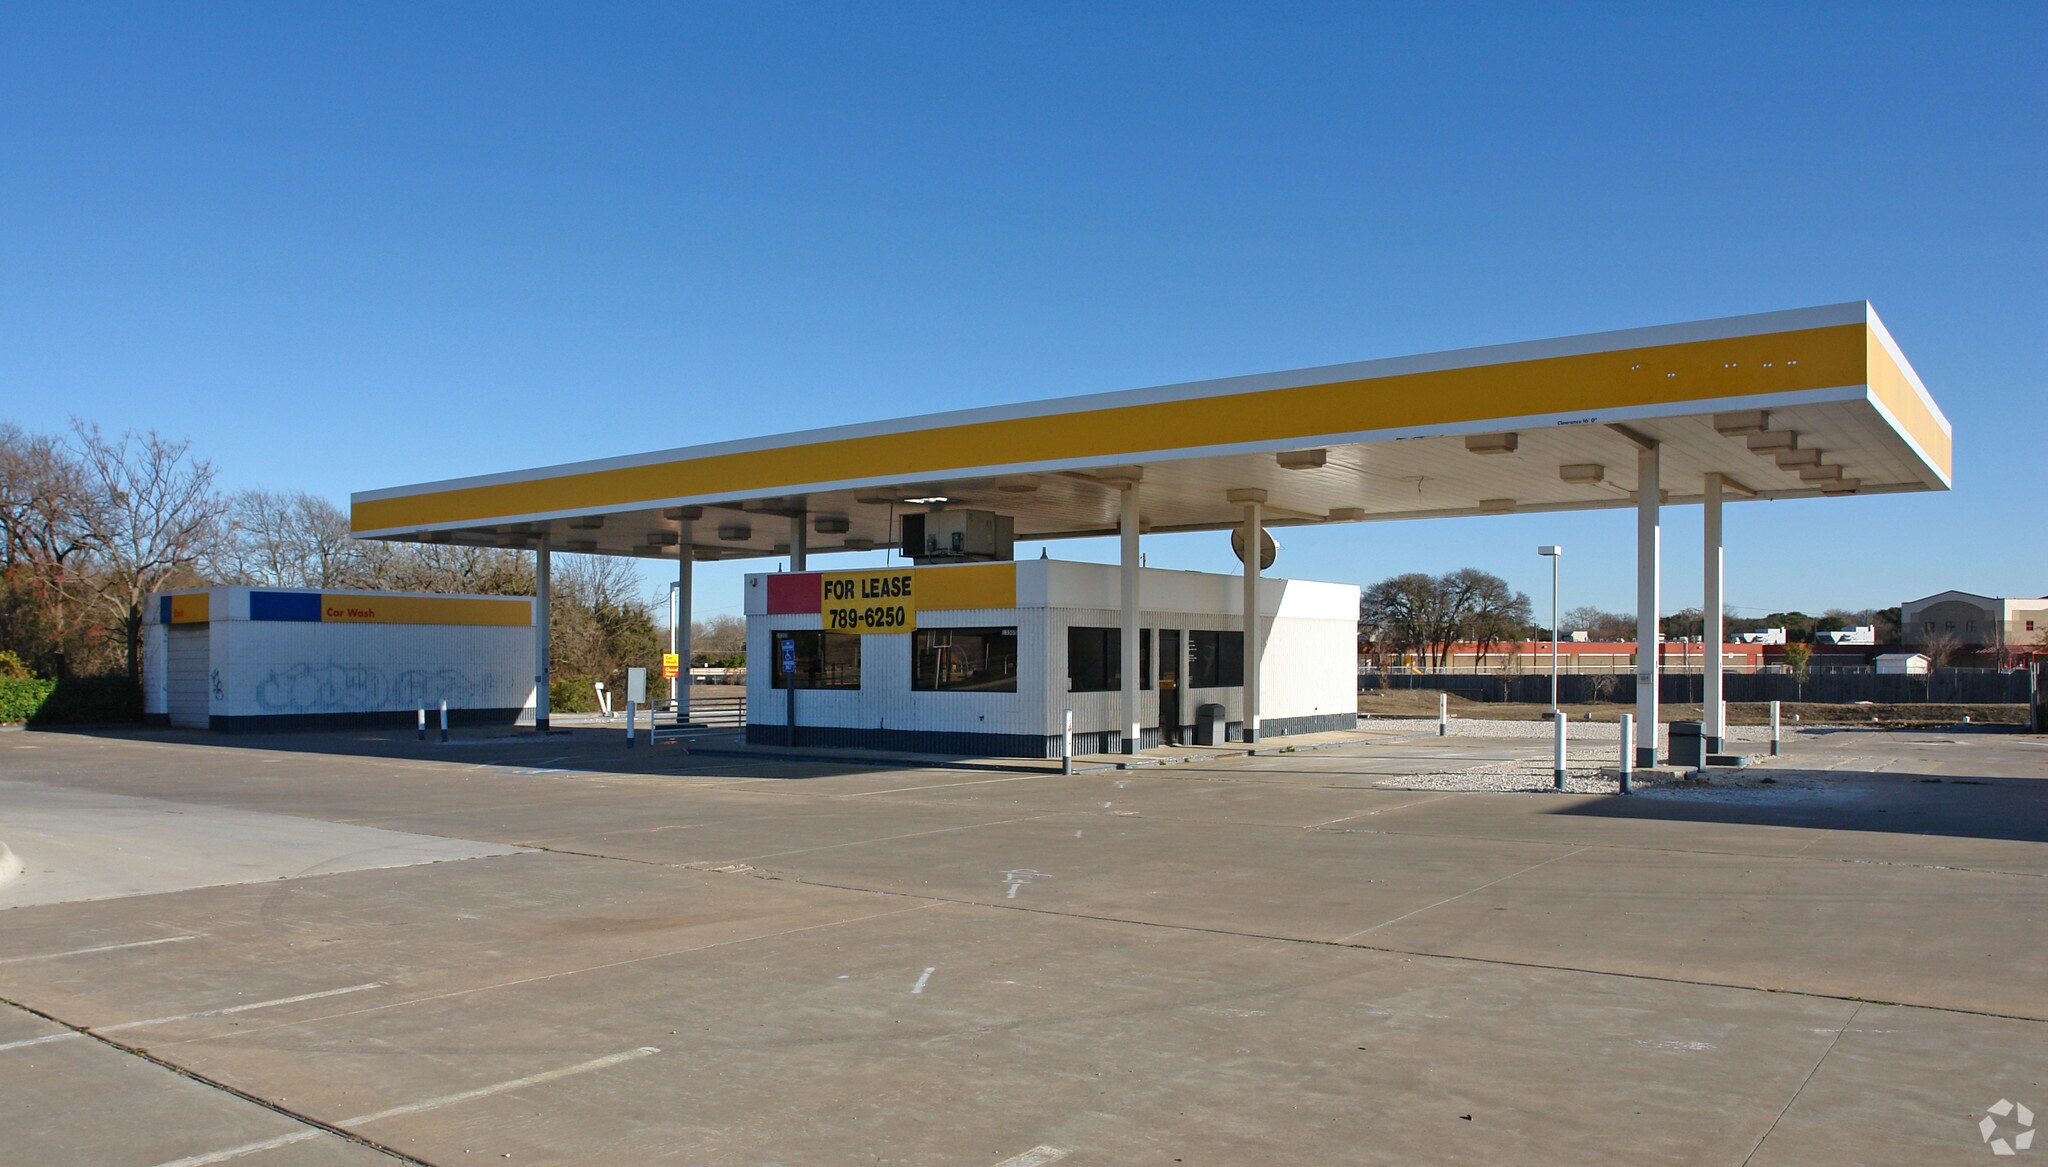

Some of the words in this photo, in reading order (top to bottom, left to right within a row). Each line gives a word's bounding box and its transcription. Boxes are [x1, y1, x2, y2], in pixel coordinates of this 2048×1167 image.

[824, 580, 855, 600] FOR
[861, 576, 912, 599] LEASE
[326, 607, 344, 617] Car
[347, 608, 375, 618] Wash
[829, 606, 905, 628] 789-6250
